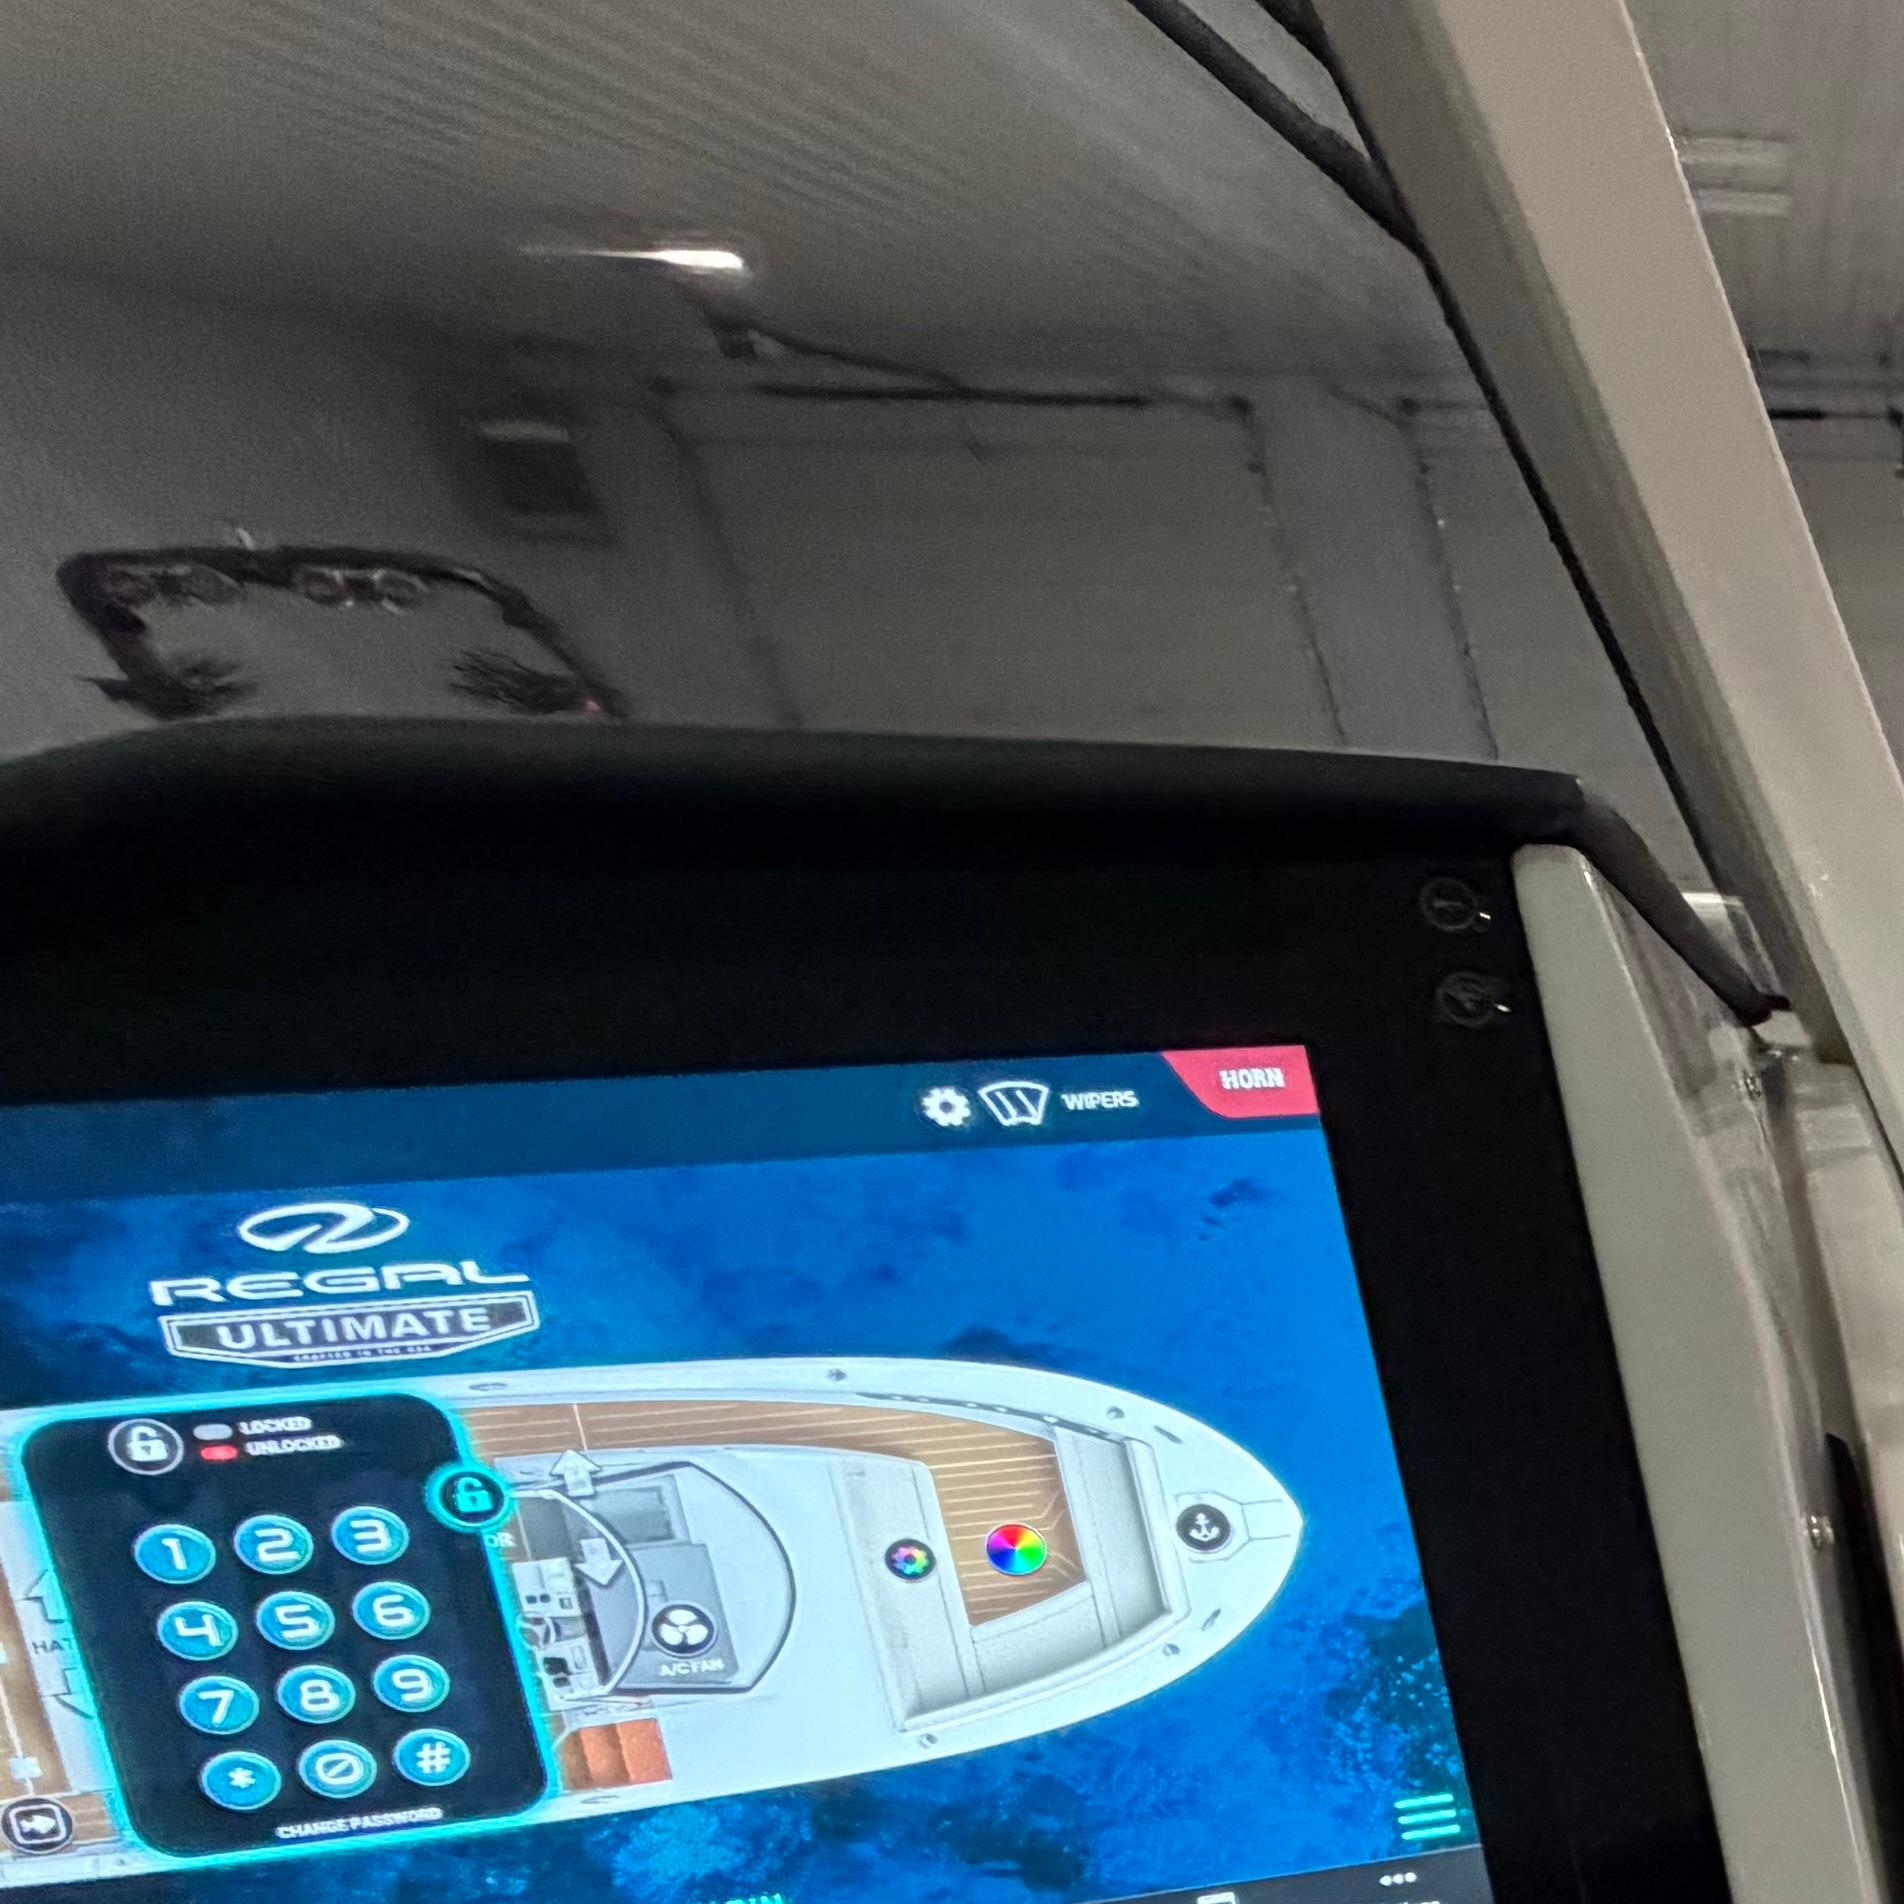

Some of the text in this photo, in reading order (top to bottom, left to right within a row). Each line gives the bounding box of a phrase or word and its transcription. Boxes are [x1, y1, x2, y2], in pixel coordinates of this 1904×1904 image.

[1218, 1067, 1286, 1091] HORN
[1060, 1089, 1140, 1111] WIPERS
[149, 1261, 531, 1306] REGAL
[215, 1306, 492, 1350] ULTIMATE
[238, 1416, 313, 1435] LOCKED
[246, 1435, 344, 1456] UNLOCKED
[161, 1519, 391, 1571] 1 2 3
[174, 1594, 415, 1648] 4 5 6
[198, 1669, 433, 1725] 7 8 9
[314, 1753, 362, 1785] 0
[275, 1807, 443, 1840] CHANGE PASSWORD
